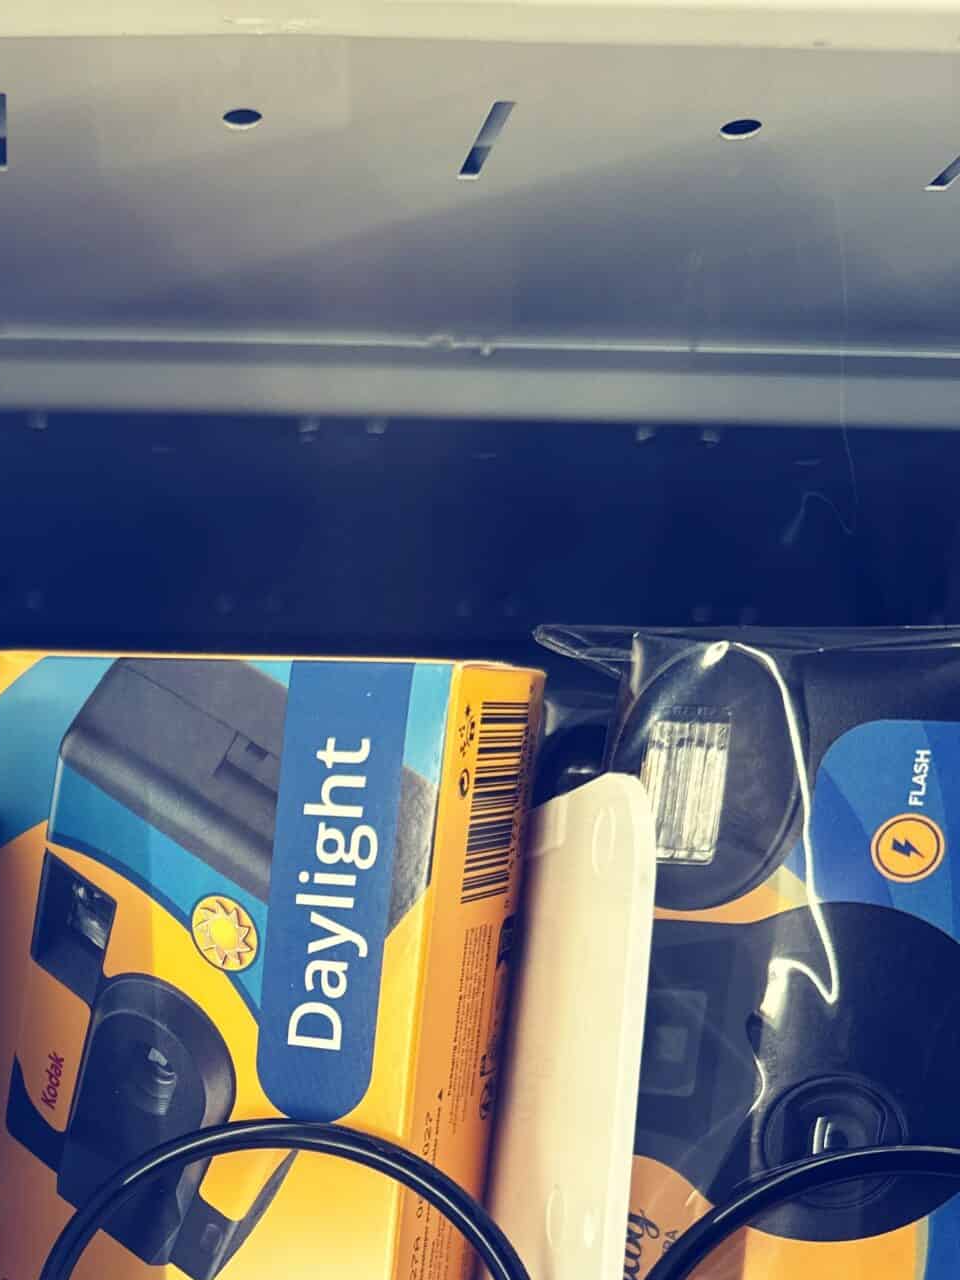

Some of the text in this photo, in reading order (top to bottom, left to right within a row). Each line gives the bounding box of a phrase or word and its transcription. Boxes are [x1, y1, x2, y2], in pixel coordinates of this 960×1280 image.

[908, 749, 931, 806] FLASH
[286, 736, 379, 1052] Daylight
[40, 1051, 65, 1111] Kodak
